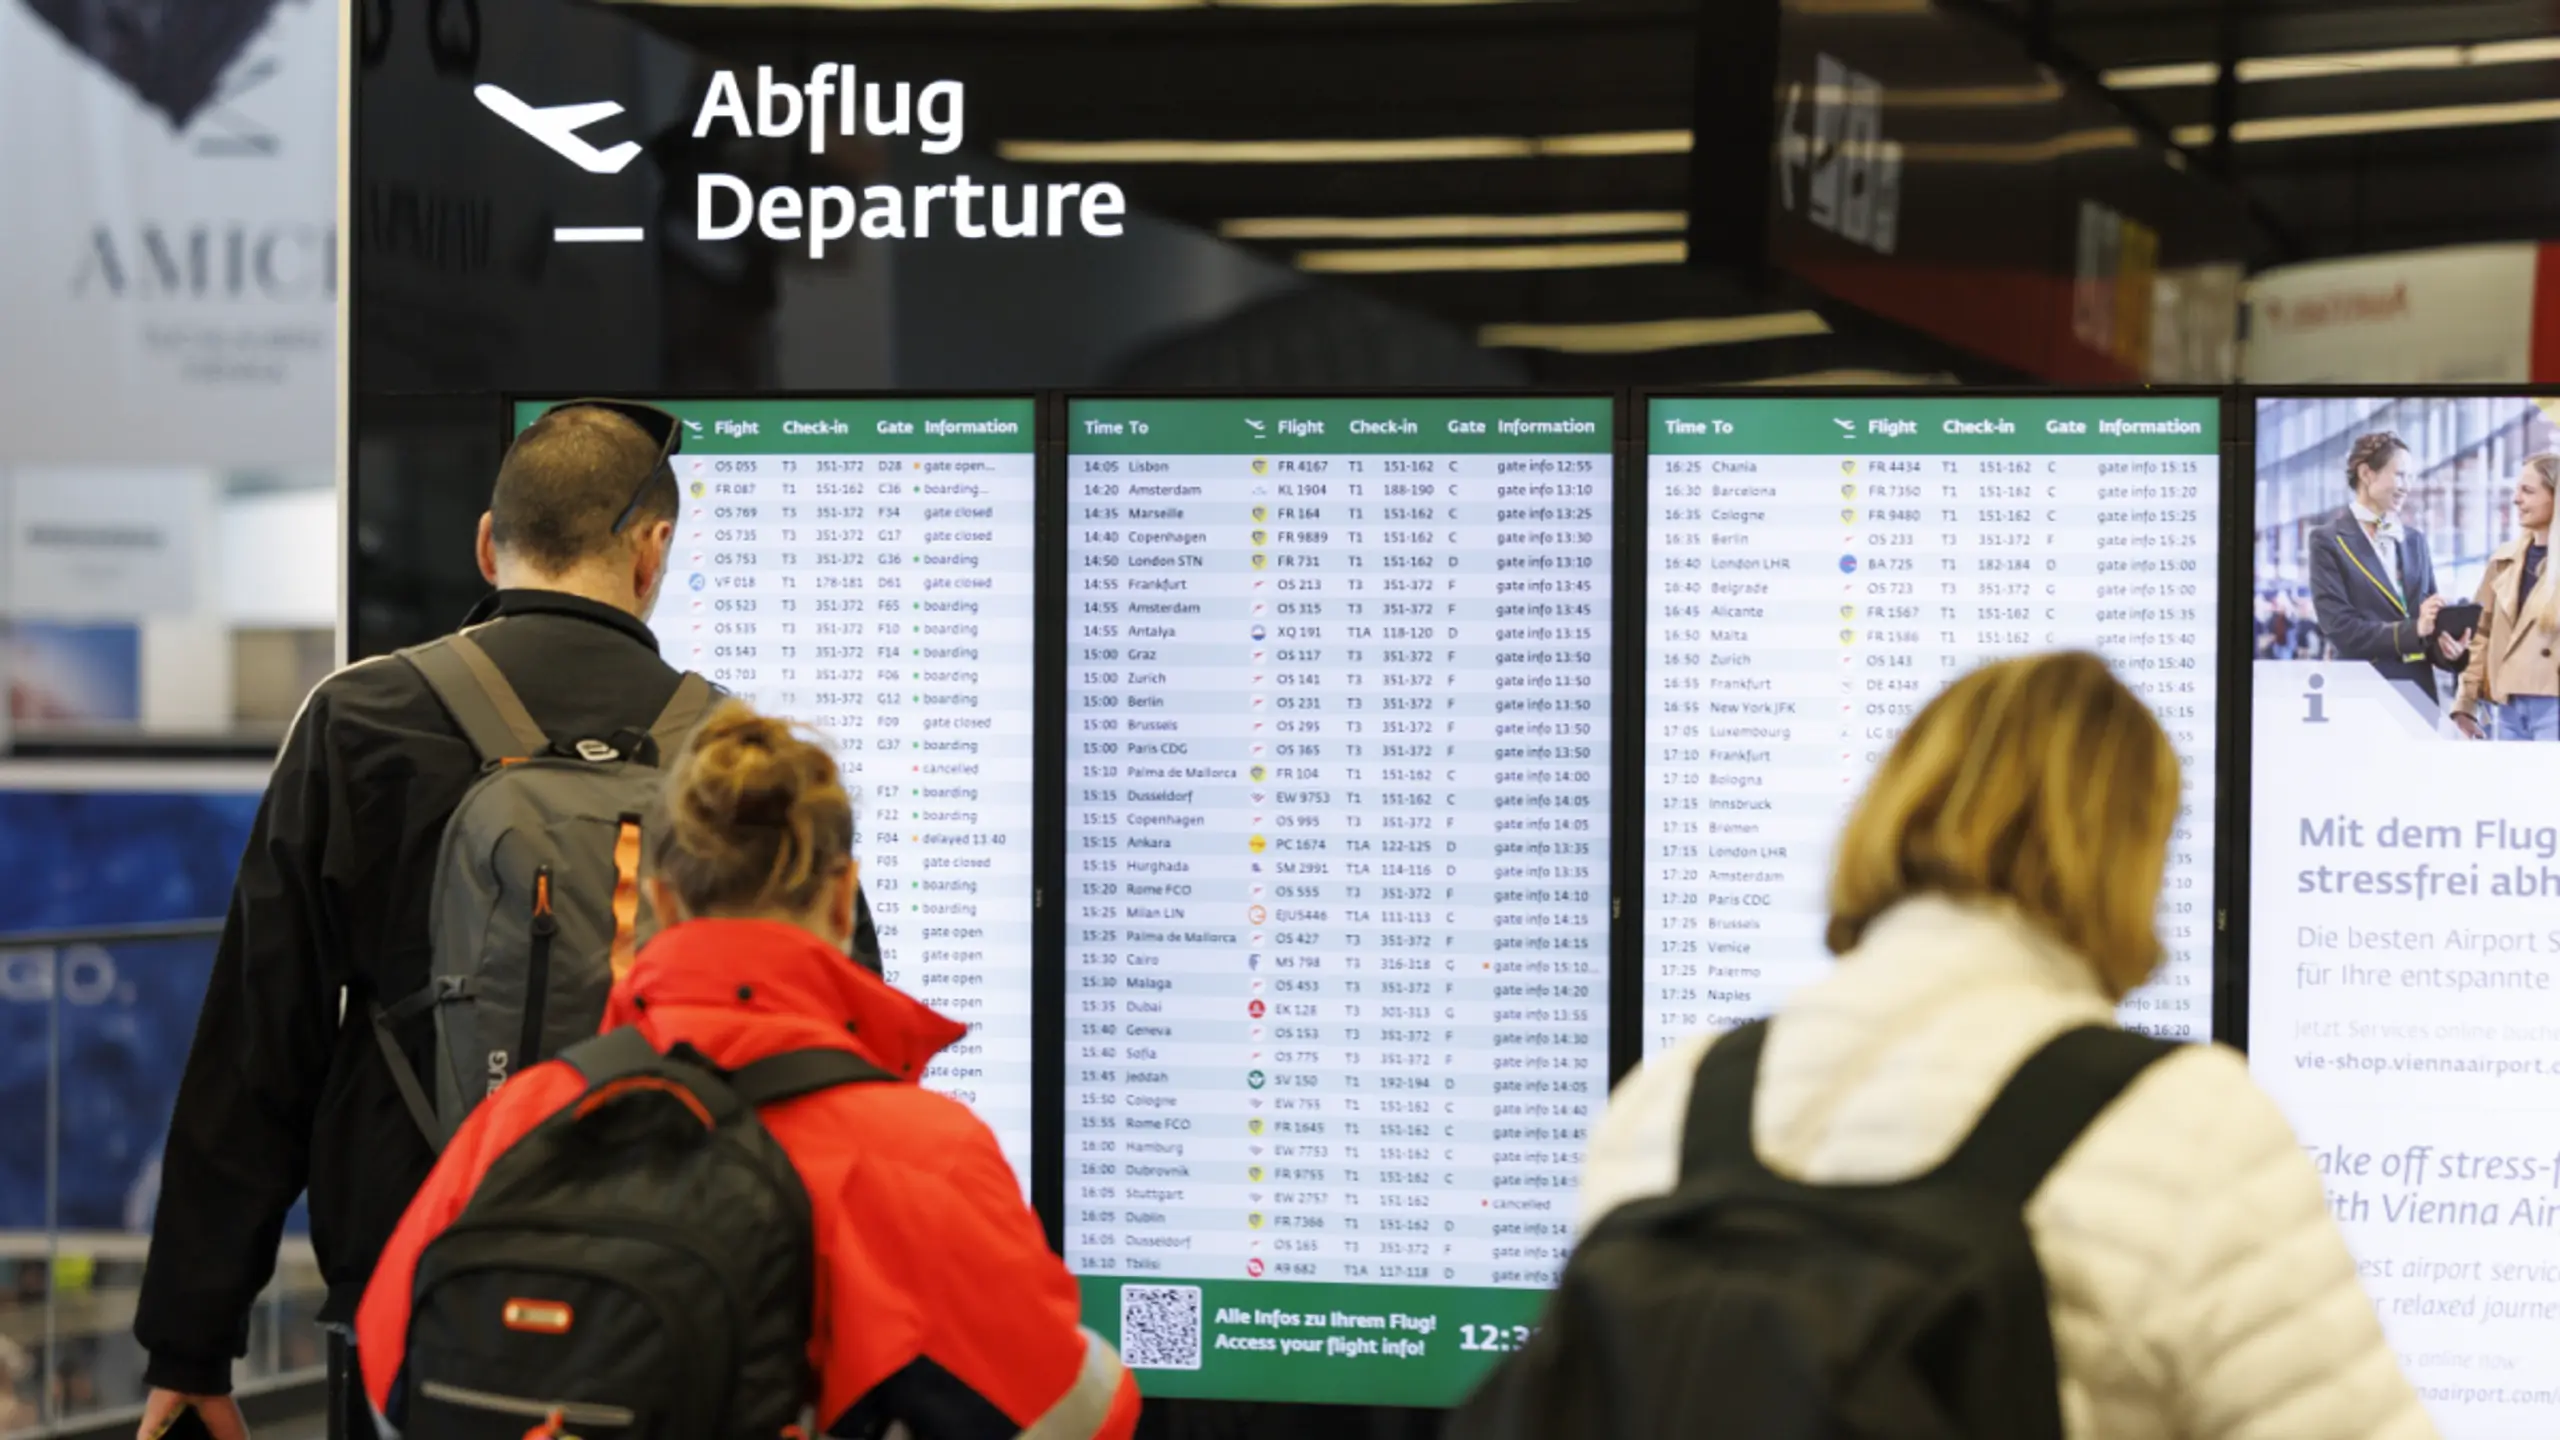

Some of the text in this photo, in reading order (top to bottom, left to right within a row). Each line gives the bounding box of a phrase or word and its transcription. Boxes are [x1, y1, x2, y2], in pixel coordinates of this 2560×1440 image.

[692, 62, 963, 154] Abflug
[698, 174, 1125, 259] Departure
[714, 417, 1019, 439] Flight Check-in Gate Information
[1084, 417, 1596, 438] Time To Flight Check-in Gate Information
[1664, 417, 2202, 438] Time To Flight Check-in Gate Information
[714, 460, 734, 473] OS
[735, 460, 758, 473] 055
[781, 460, 798, 473] T3
[816, 460, 864, 473] 351-372
[878, 460, 903, 472] D28
[923, 460, 953, 475] gate
[1084, 458, 1594, 475] 14:05 Lisbon FR 4167 T1 151-162 C gate info 12:55
[1665, 460, 2198, 477] 16:25 Chania FR 4434 T1 151-162 C gate info 15:15
[715, 483, 732, 495] FR
[733, 482, 757, 495] 087
[781, 482, 797, 495] T1
[816, 482, 864, 495] 151-162
[877, 482, 902, 495] C36
[1084, 482, 1594, 499] 14:20 Amsterdam KL 1904 T1 188-190 C gate info 13:10
[1711, 484, 1777, 497] Barcelona
[1084, 506, 1593, 523] 14:35 Marseille FR 164 T1 151-162 C gate info 13:25
[1084, 530, 1593, 547] 14:40 Copenhagen FR 9889 T1 151-162 C gate info 13:30
[1084, 554, 1203, 567] 14:50 London STN
[1710, 557, 1791, 571] London LHR
[1084, 577, 1187, 592] 14:55 Frankfurt
[1127, 624, 1176, 640] Antalya
[1127, 648, 1157, 661] Graz
[1710, 701, 1740, 714] New
[1741, 702, 1773, 714] York
[922, 763, 980, 776] cancelled
[1126, 765, 1237, 779] Palma de Mallorca
[1126, 788, 1194, 805] Dusseldorf
[876, 831, 900, 844] F04
[922, 833, 970, 847] delayed
[1126, 836, 1172, 849] Ankara
[2300, 815, 2557, 859] Mit dem Flug
[2298, 863, 2478, 901] stressfrei
[921, 927, 984, 941] gate open
[2298, 925, 2338, 948] Die
[2349, 926, 2433, 950] besten
[2444, 928, 2538, 957] Airport
[1707, 940, 1751, 954] Venice
[1126, 953, 1160, 966] Cairo
[2296, 962, 2549, 992] für Ihre entspannte
[1707, 989, 1752, 1004] Naples
[1125, 1000, 1163, 1013] Dubai
[2301, 1144, 2371, 1176] ake
[2382, 1145, 2433, 1186] off
[2325, 1189, 2369, 1222] ith
[2382, 1192, 2499, 1226] Vienna
[2358, 1259, 2393, 1278] est
[2402, 1257, 2481, 1283] airport
[2393, 1293, 2475, 1317] relaxed
[1214, 1307, 1436, 1334] Alle Infos zu Ihrem Flug!
[1213, 1333, 1425, 1358] Access your flight info!
[1459, 1324, 1540, 1351] 12:3
